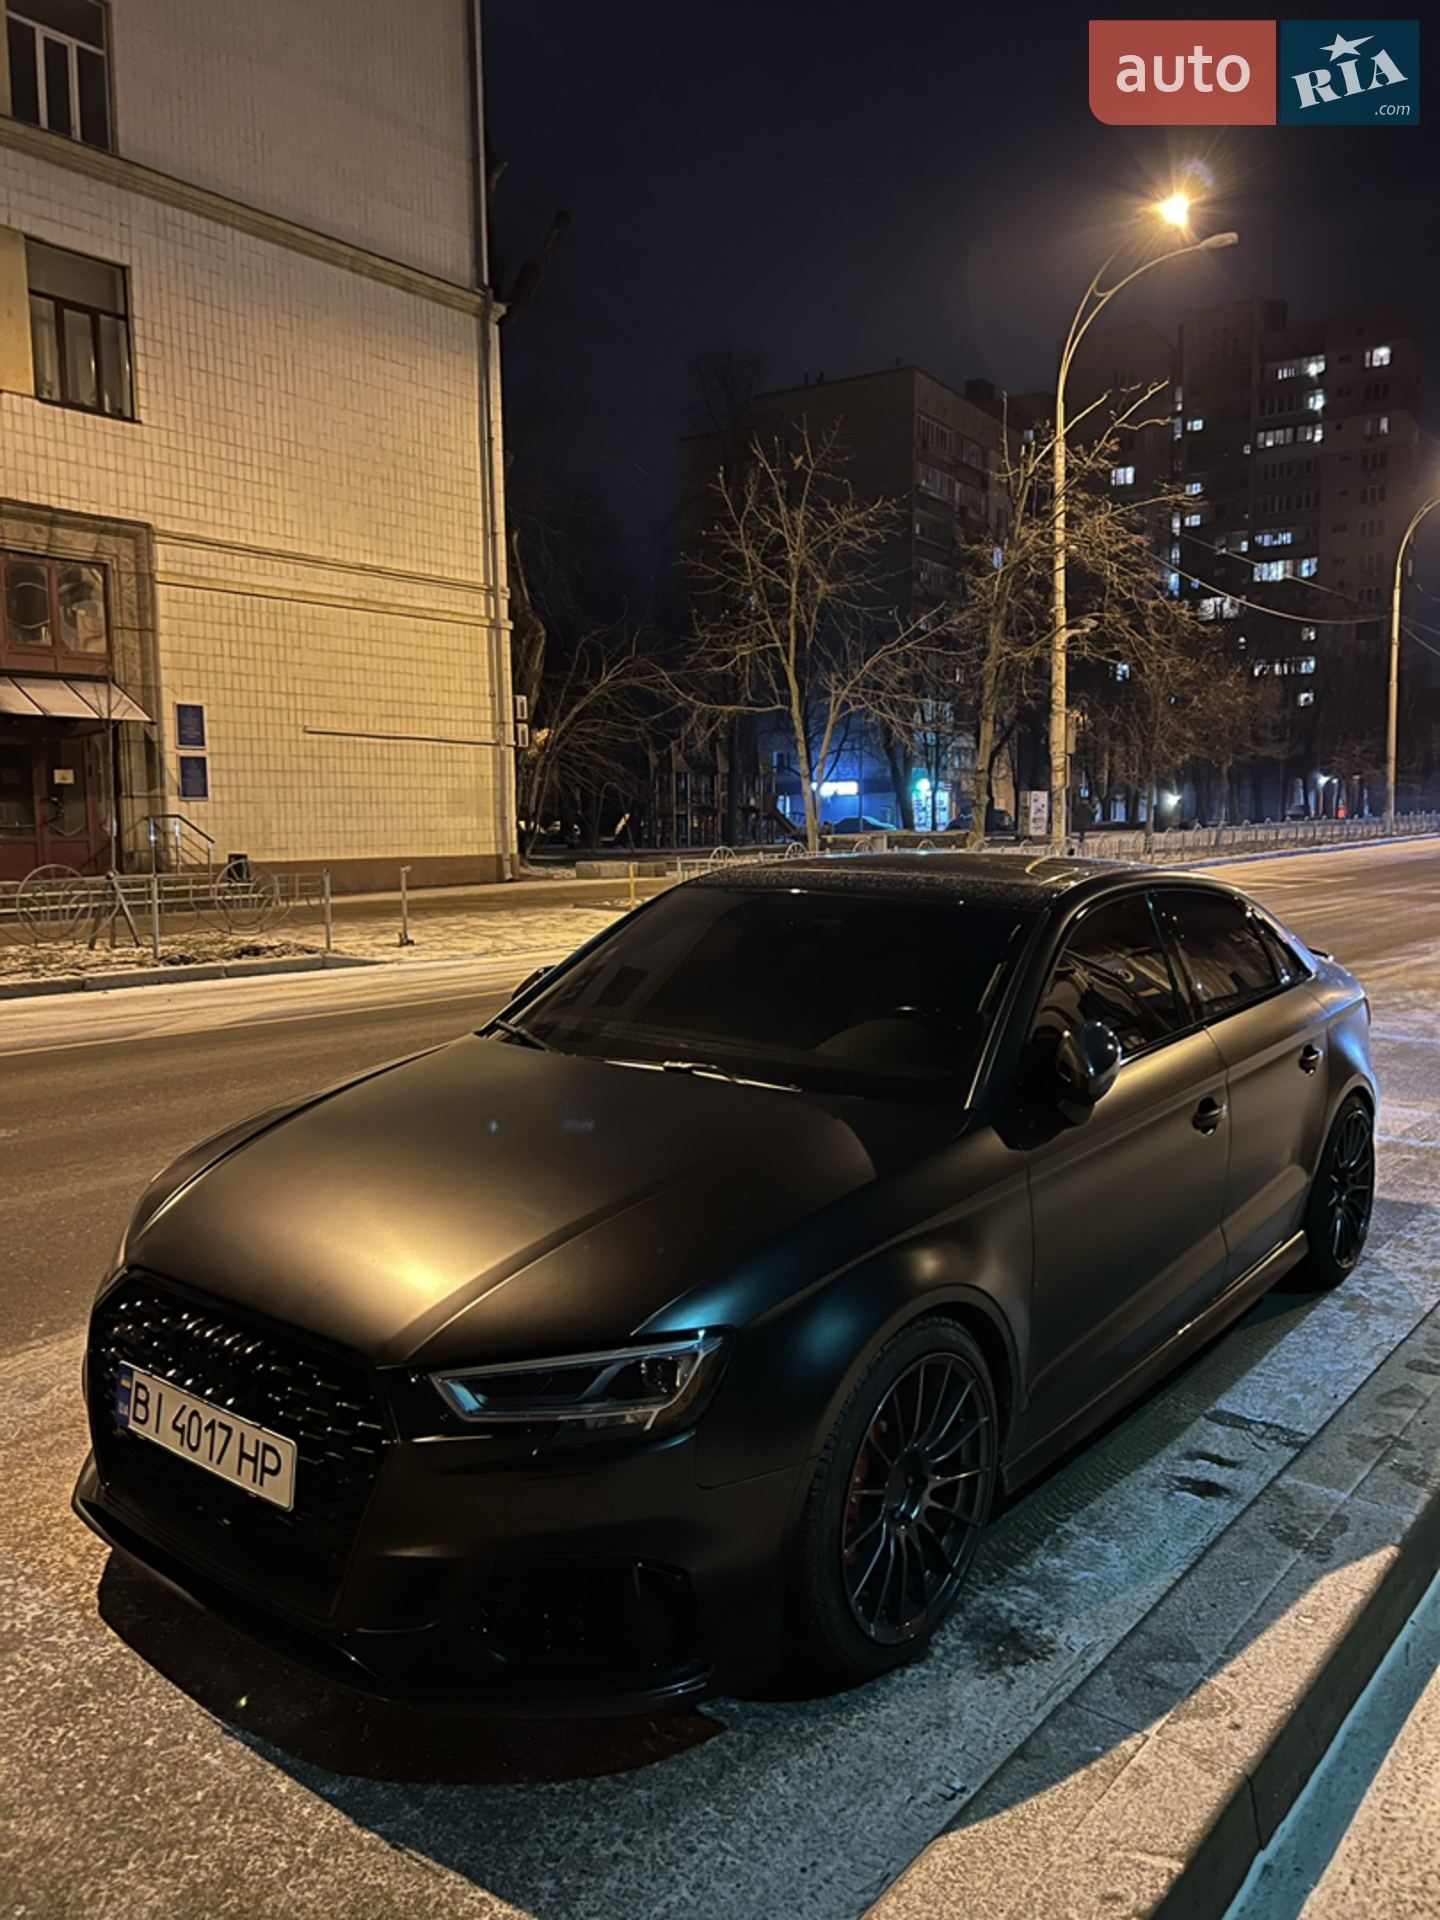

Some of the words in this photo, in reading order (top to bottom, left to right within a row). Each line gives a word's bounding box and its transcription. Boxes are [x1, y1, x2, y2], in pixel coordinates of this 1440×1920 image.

[132, 1380, 163, 1435] BI
[171, 1403, 234, 1466] 4017
[237, 1431, 283, 1488] HP
